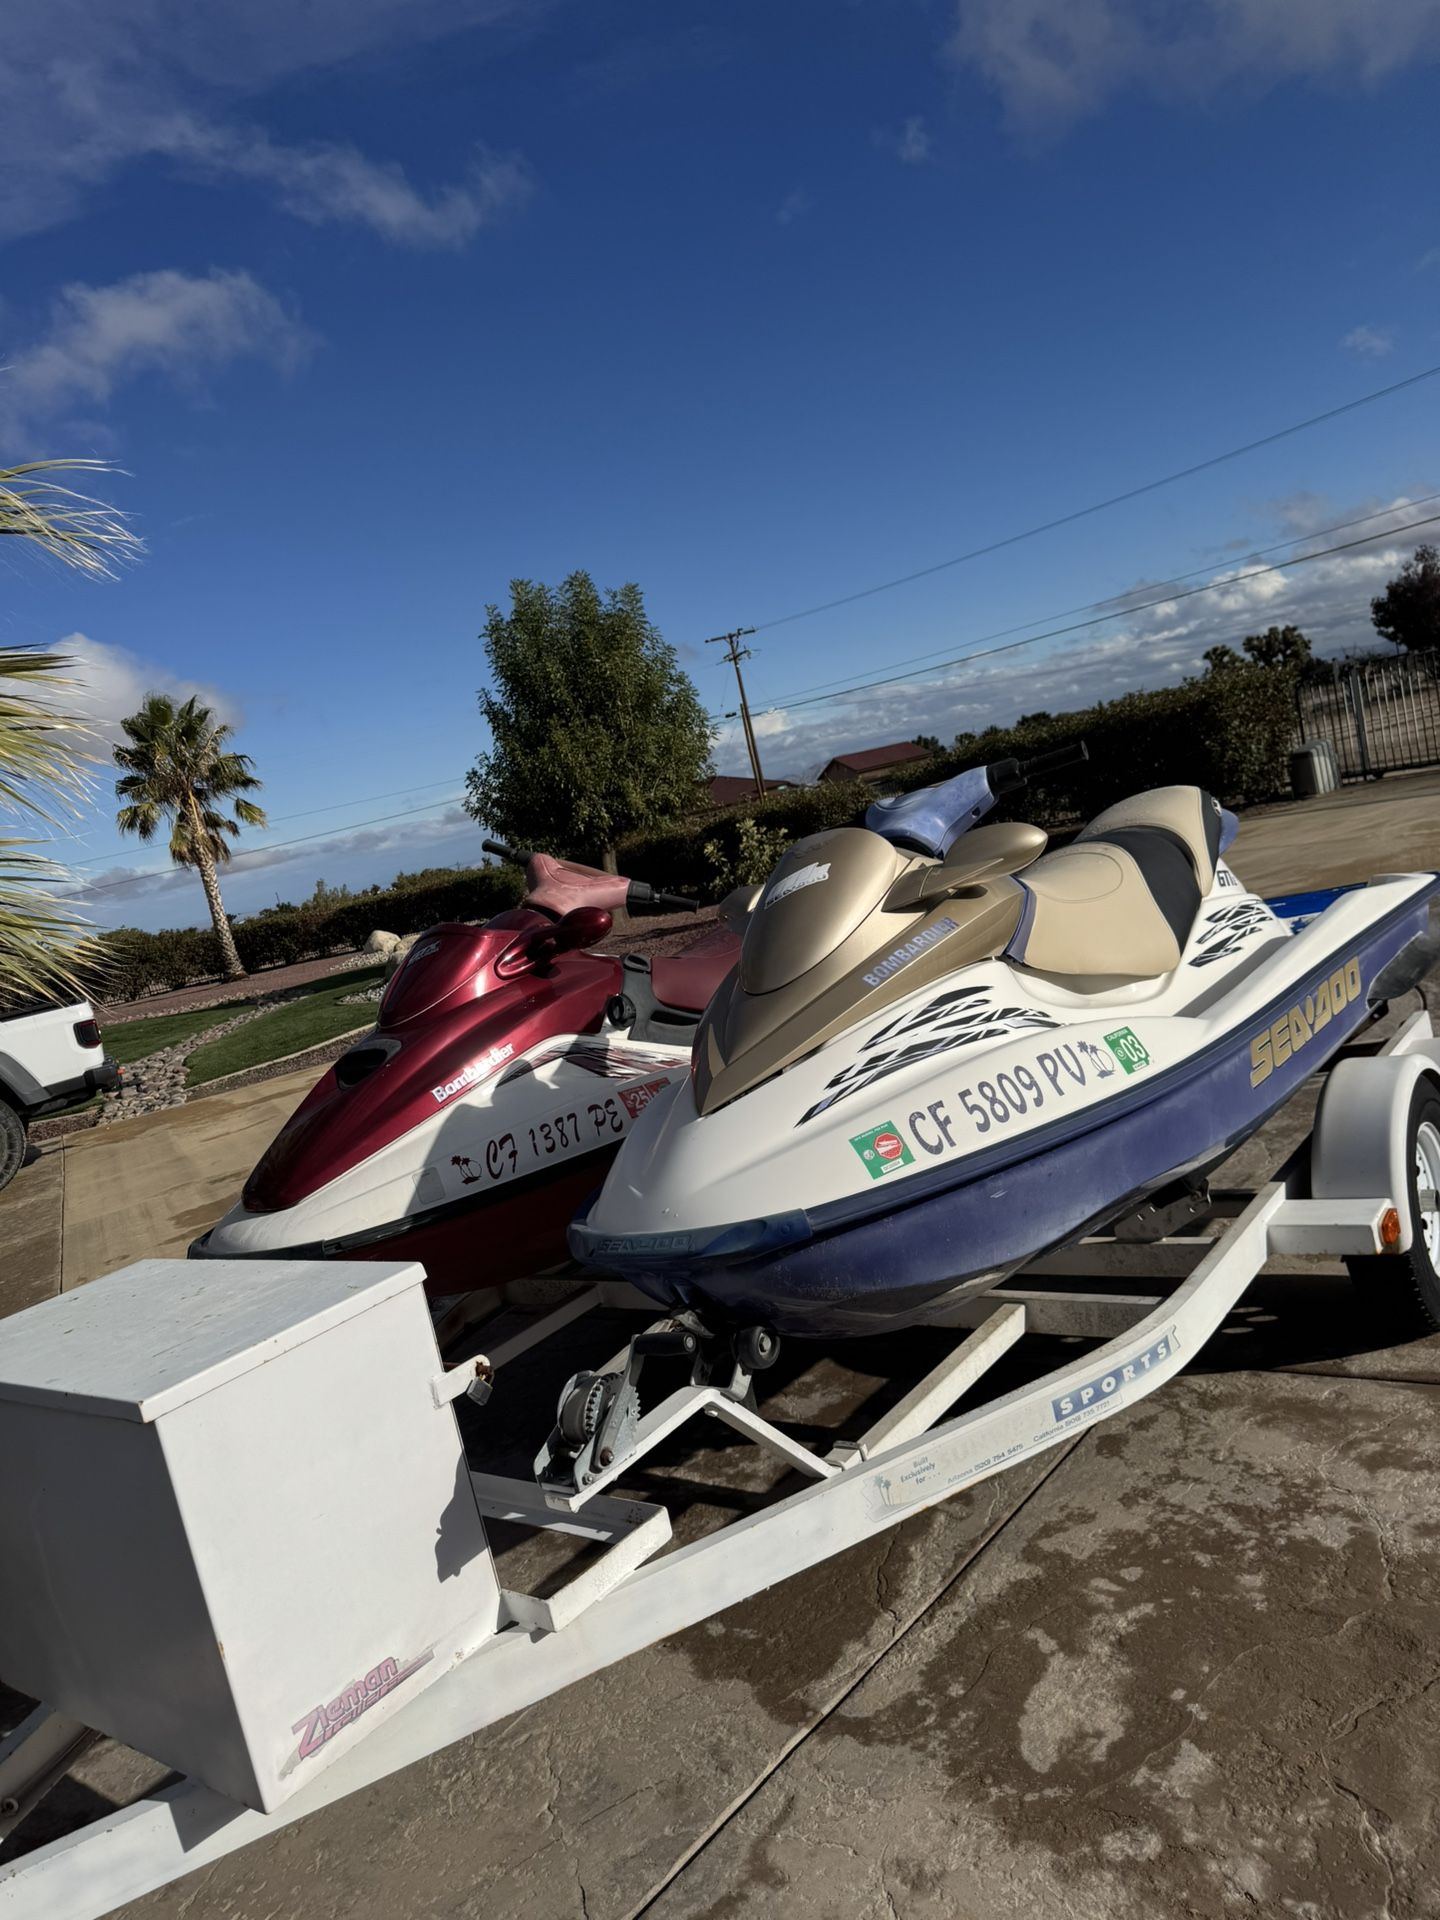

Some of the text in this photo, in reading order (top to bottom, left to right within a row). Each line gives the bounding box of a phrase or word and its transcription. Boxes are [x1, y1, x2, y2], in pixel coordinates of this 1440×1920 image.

[1120, 1035, 1146, 1062] 03
[528, 1112, 581, 1157] 1387
[587, 1099, 623, 1137] PE
[630, 1090, 650, 1109] 25
[908, 1043, 1086, 1155] CF 5809 PV
[1059, 1341, 1167, 1415] SPORTS
[291, 1656, 399, 1760] Zieman
